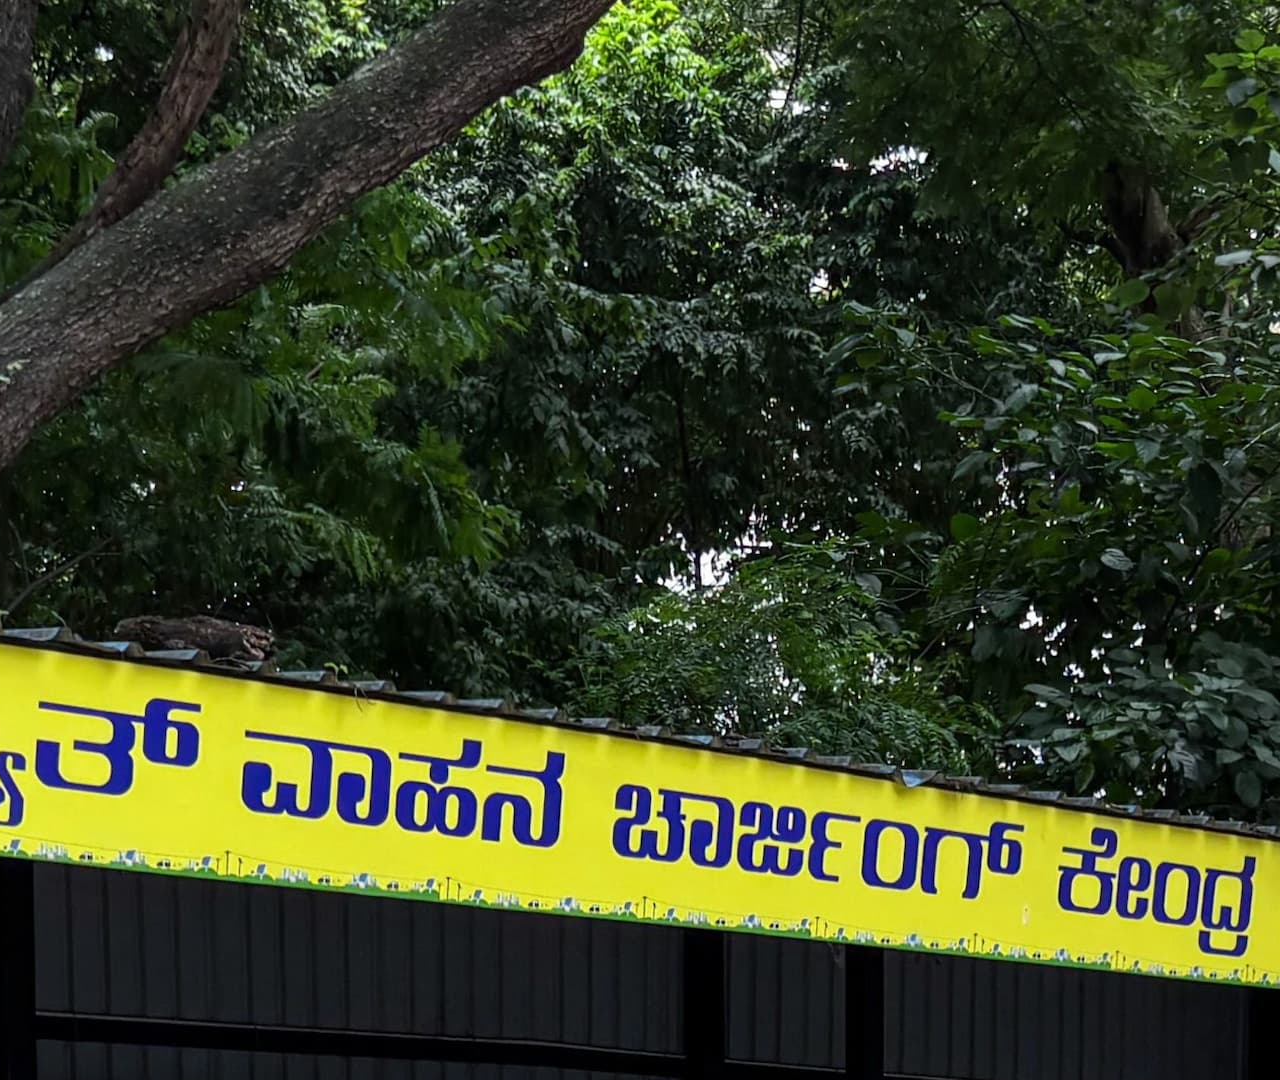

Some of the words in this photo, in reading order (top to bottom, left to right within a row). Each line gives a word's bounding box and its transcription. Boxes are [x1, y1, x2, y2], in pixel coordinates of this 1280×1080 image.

[241, 730, 565, 848] ವಾಹನ
[612, 784, 1022, 899] ಚಾರ್ಜಿಂಗ್
[1057, 827, 1256, 958] ಕೇಂದ್ರ
